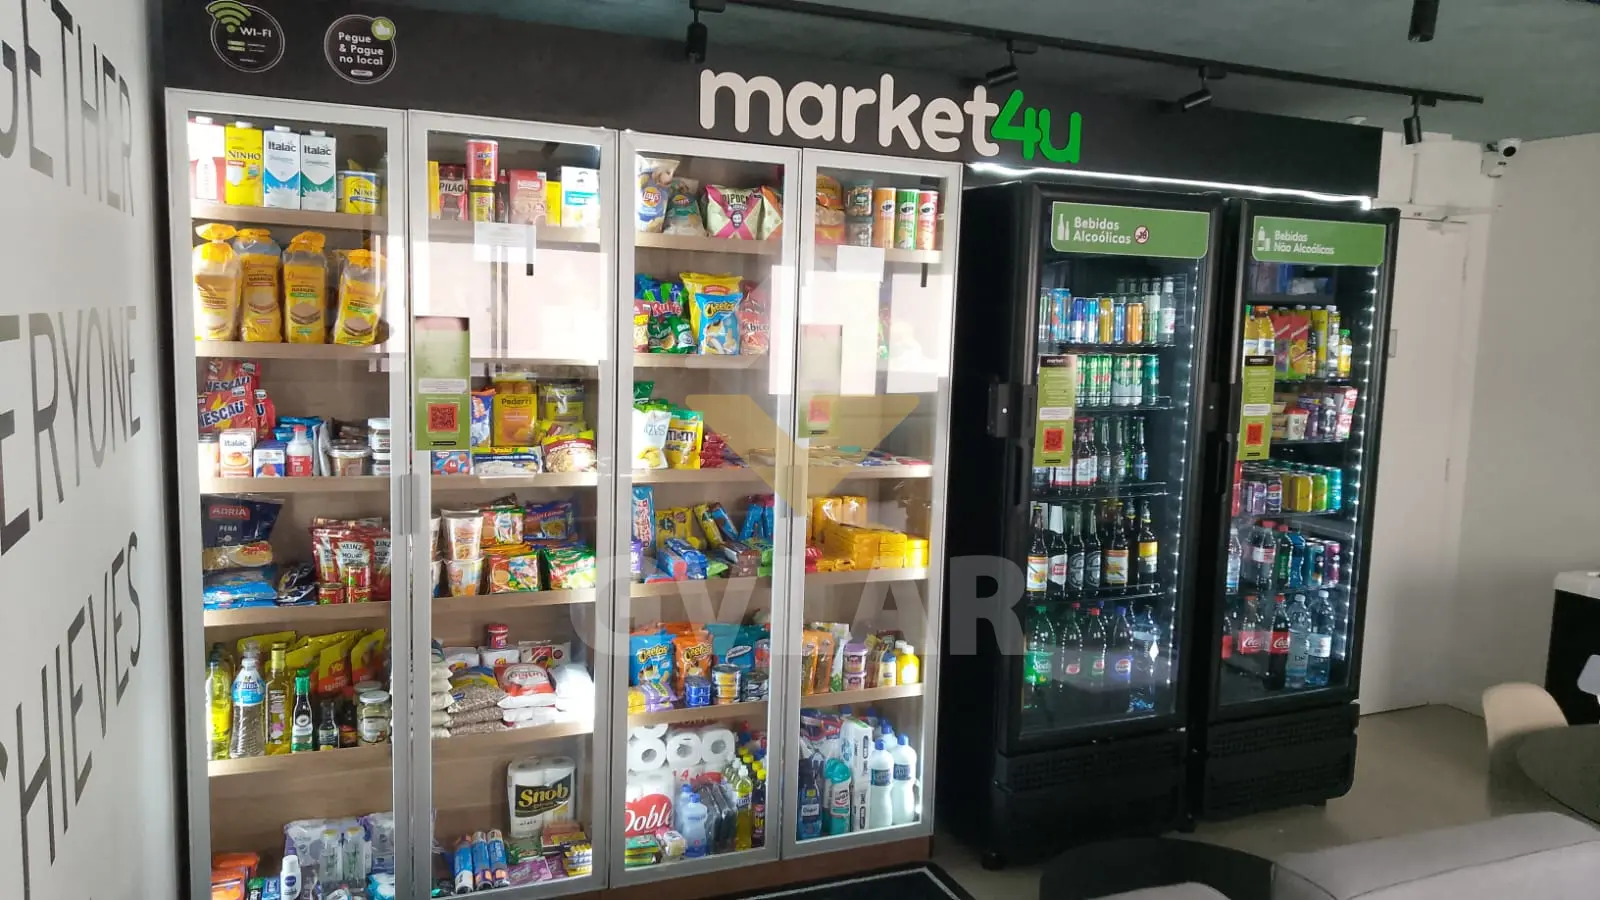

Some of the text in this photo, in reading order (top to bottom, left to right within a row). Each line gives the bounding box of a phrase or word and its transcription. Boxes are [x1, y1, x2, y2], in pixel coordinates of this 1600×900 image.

[338, 31, 372, 44] Pegue
[339, 44, 384, 56] & Pague
[339, 55, 384, 66] no local
[698, 68, 1083, 164] market4u
[267, 140, 297, 153] Italac
[303, 143, 332, 156] Italac
[228, 149, 261, 161] NINHO
[1074, 216, 1120, 231] Bebidas
[1073, 229, 1132, 245] Alcoólicas
[1274, 230, 1308, 242] Bebidas
[1273, 241, 1335, 255] Não Alcoólicas
[518, 783, 569, 808] Snob
